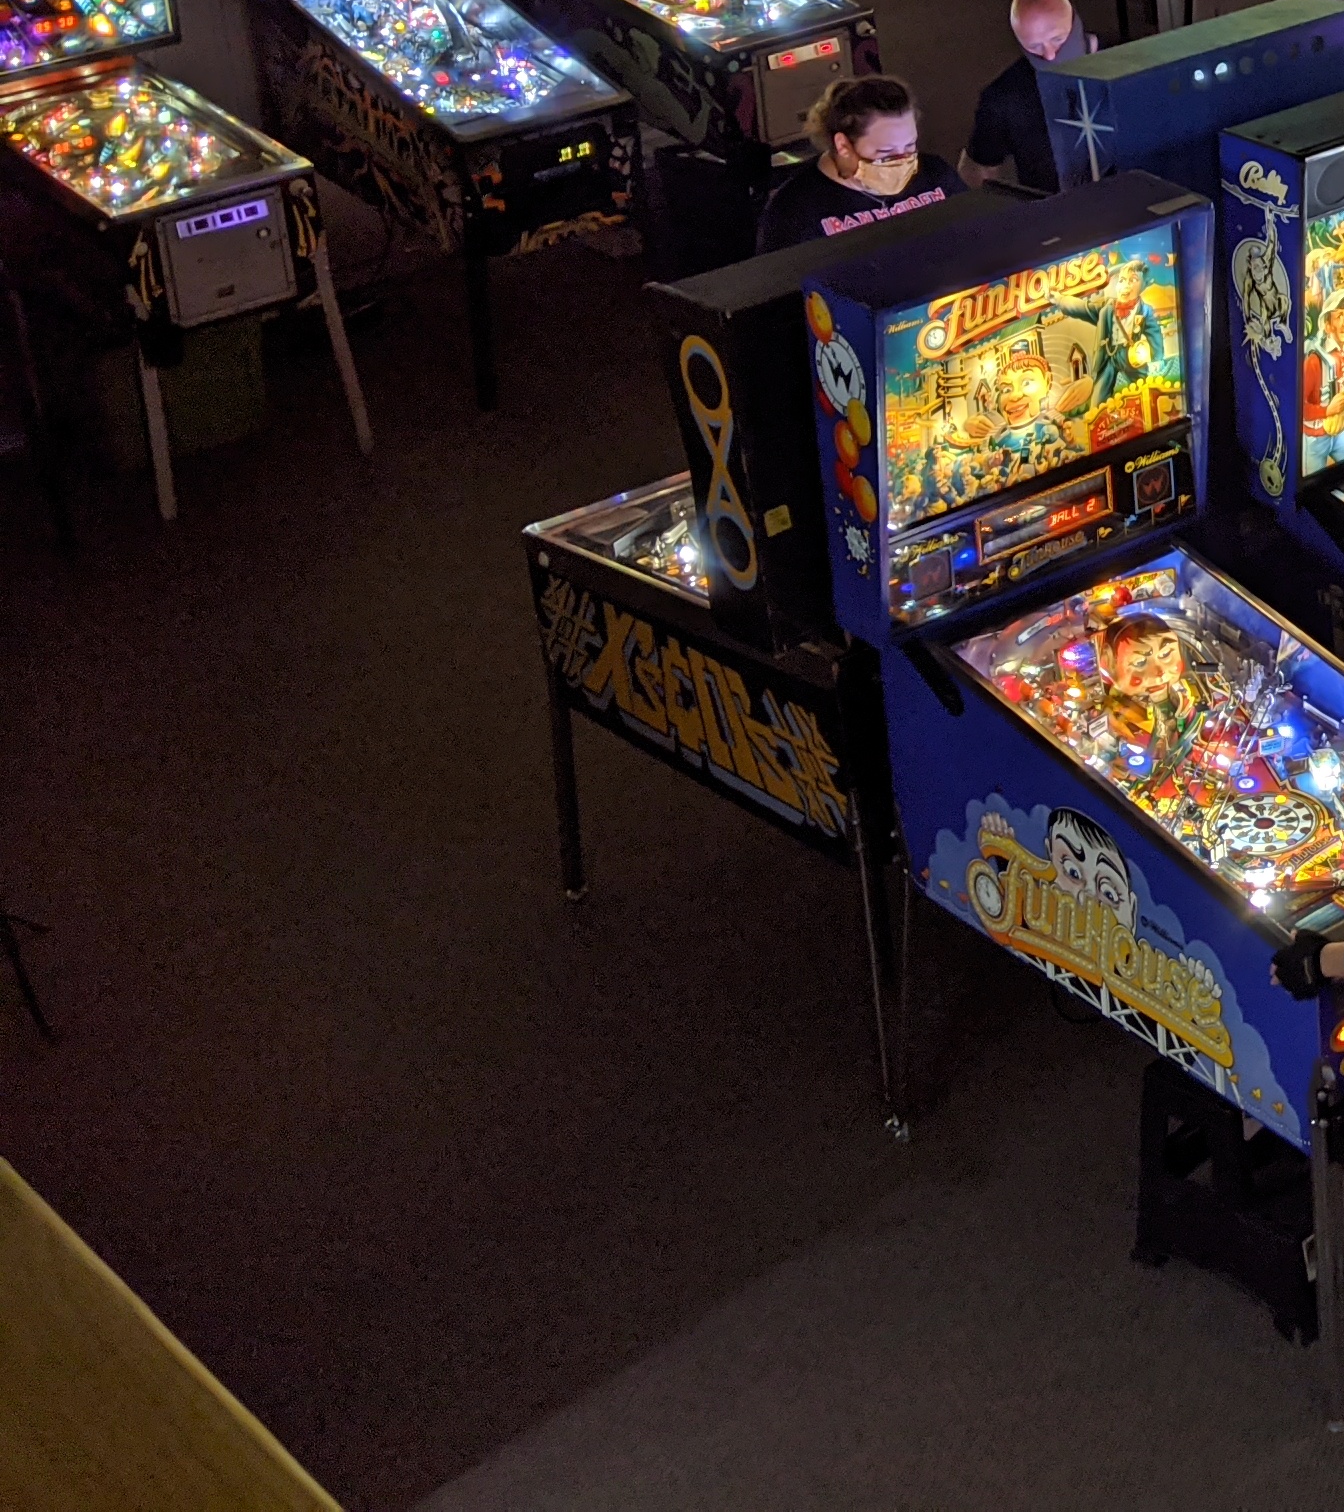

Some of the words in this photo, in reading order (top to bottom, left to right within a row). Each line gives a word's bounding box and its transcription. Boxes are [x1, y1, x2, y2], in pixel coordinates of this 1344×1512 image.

[1239, 160, 1289, 205] Bally
[872, 188, 946, 222] MAIDEN
[883, 317, 924, 335] Williams
[1134, 448, 1180, 470] Williams
[1049, 505, 1080, 527] BALL
[1086, 497, 1096, 512] 2
